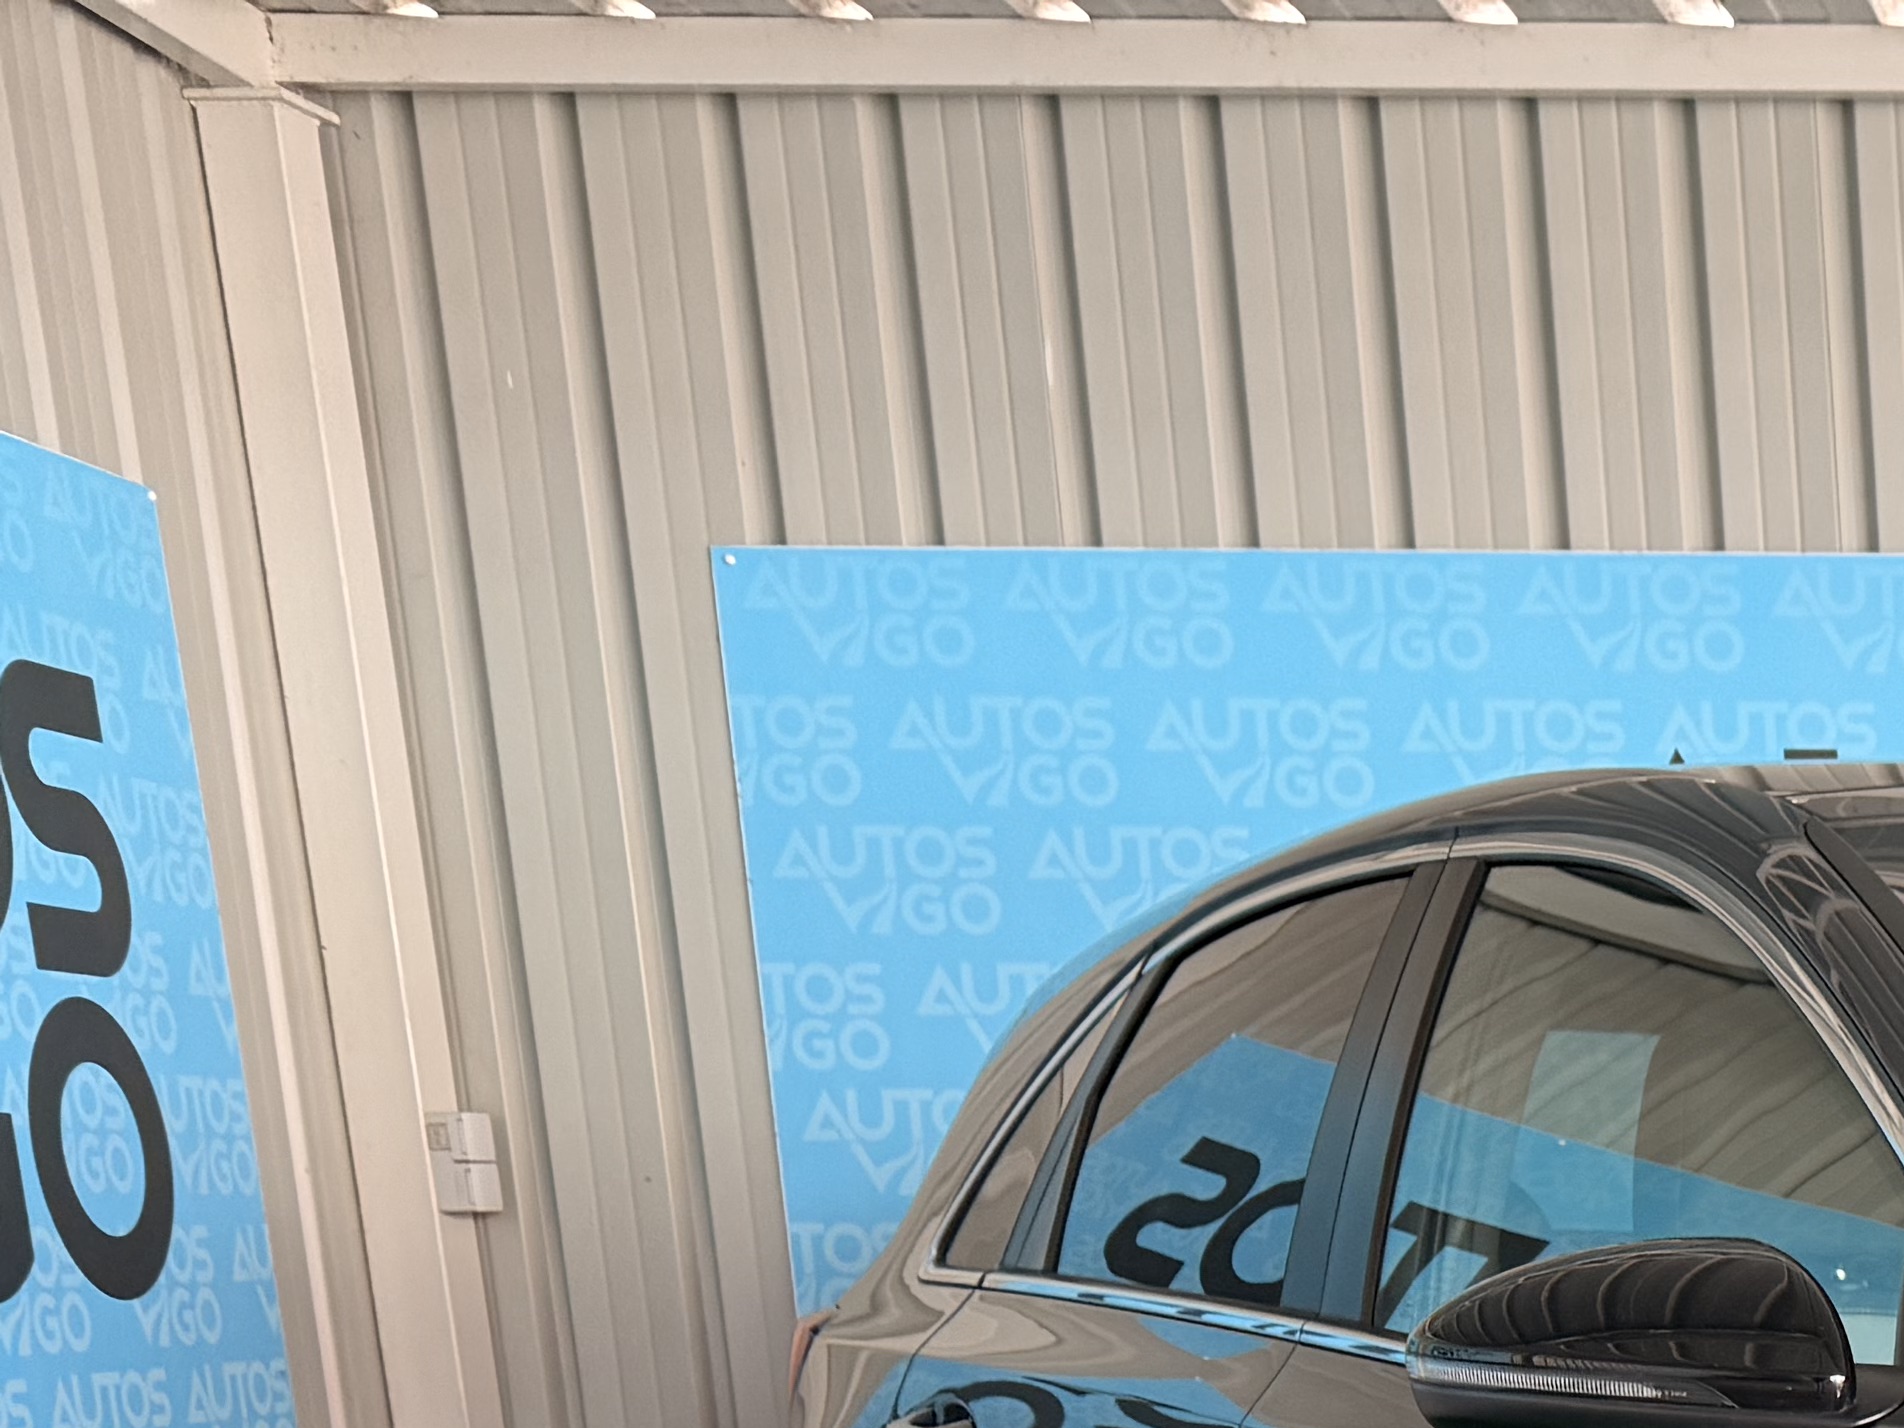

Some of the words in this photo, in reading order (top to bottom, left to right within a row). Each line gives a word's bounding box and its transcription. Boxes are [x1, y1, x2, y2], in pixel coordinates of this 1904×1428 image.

[744, 556, 970, 612] AUTOS
[1003, 557, 1230, 614] AUTOS
[1260, 559, 1487, 616] AUTOS
[1517, 561, 1741, 617] AUTOS
[792, 612, 976, 668] VIGO
[1052, 614, 1234, 670] VIGO
[1310, 615, 1490, 673] VIGO
[1567, 617, 1746, 673] VIGO
[890, 696, 1115, 751] AUTOS
[1147, 698, 1371, 753] AUTOS
[1403, 699, 1626, 753] AUTOS
[1657, 701, 1878, 755] AUTOS
[938, 751, 1119, 807] VIGO
[1197, 754, 1375, 809] VIGO
[771, 824, 998, 880] AUTOS
[821, 880, 1002, 934] VIGO
[159, 1073, 249, 1137] UTOS
[188, 1356, 294, 1424] AUTOS
